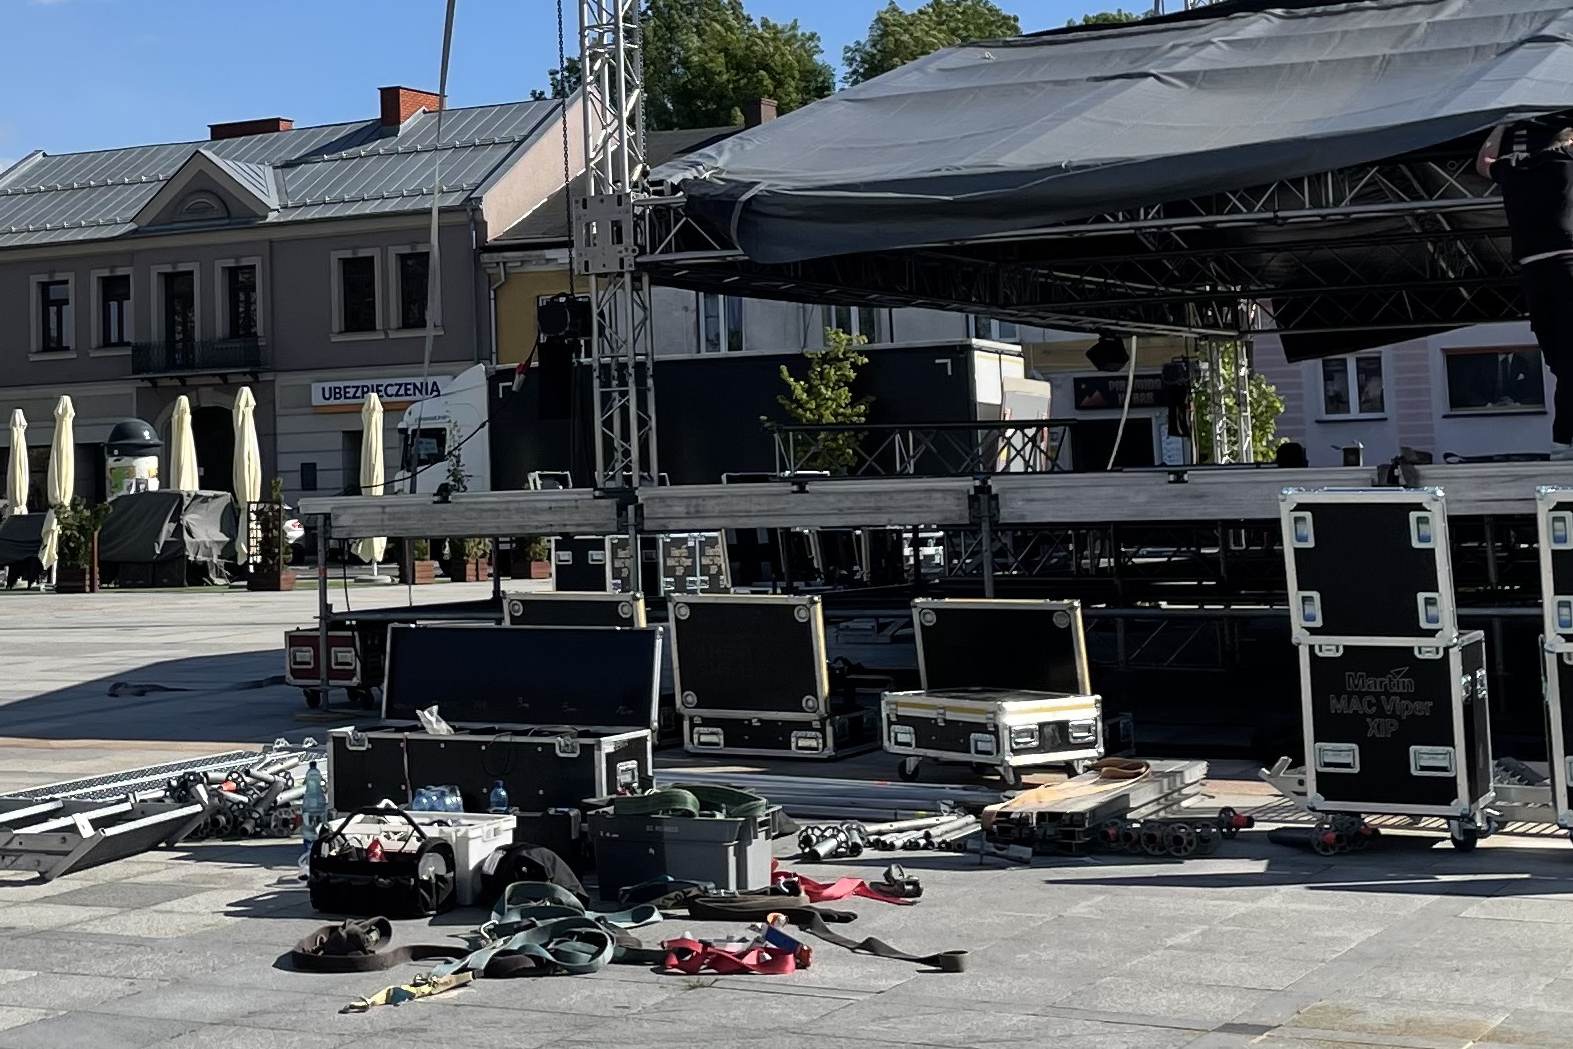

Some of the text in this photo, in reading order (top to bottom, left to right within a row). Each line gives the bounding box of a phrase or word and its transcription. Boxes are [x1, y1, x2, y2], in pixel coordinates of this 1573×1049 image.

[321, 381, 441, 401] UBEZPIECZENIA
[1108, 378, 1162, 391] PIRMIDA
[1117, 392, 1155, 405] KBAB
[1346, 668, 1415, 692] Martin
[1329, 694, 1433, 719] MAC Viper
[1366, 718, 1399, 738] XIP
